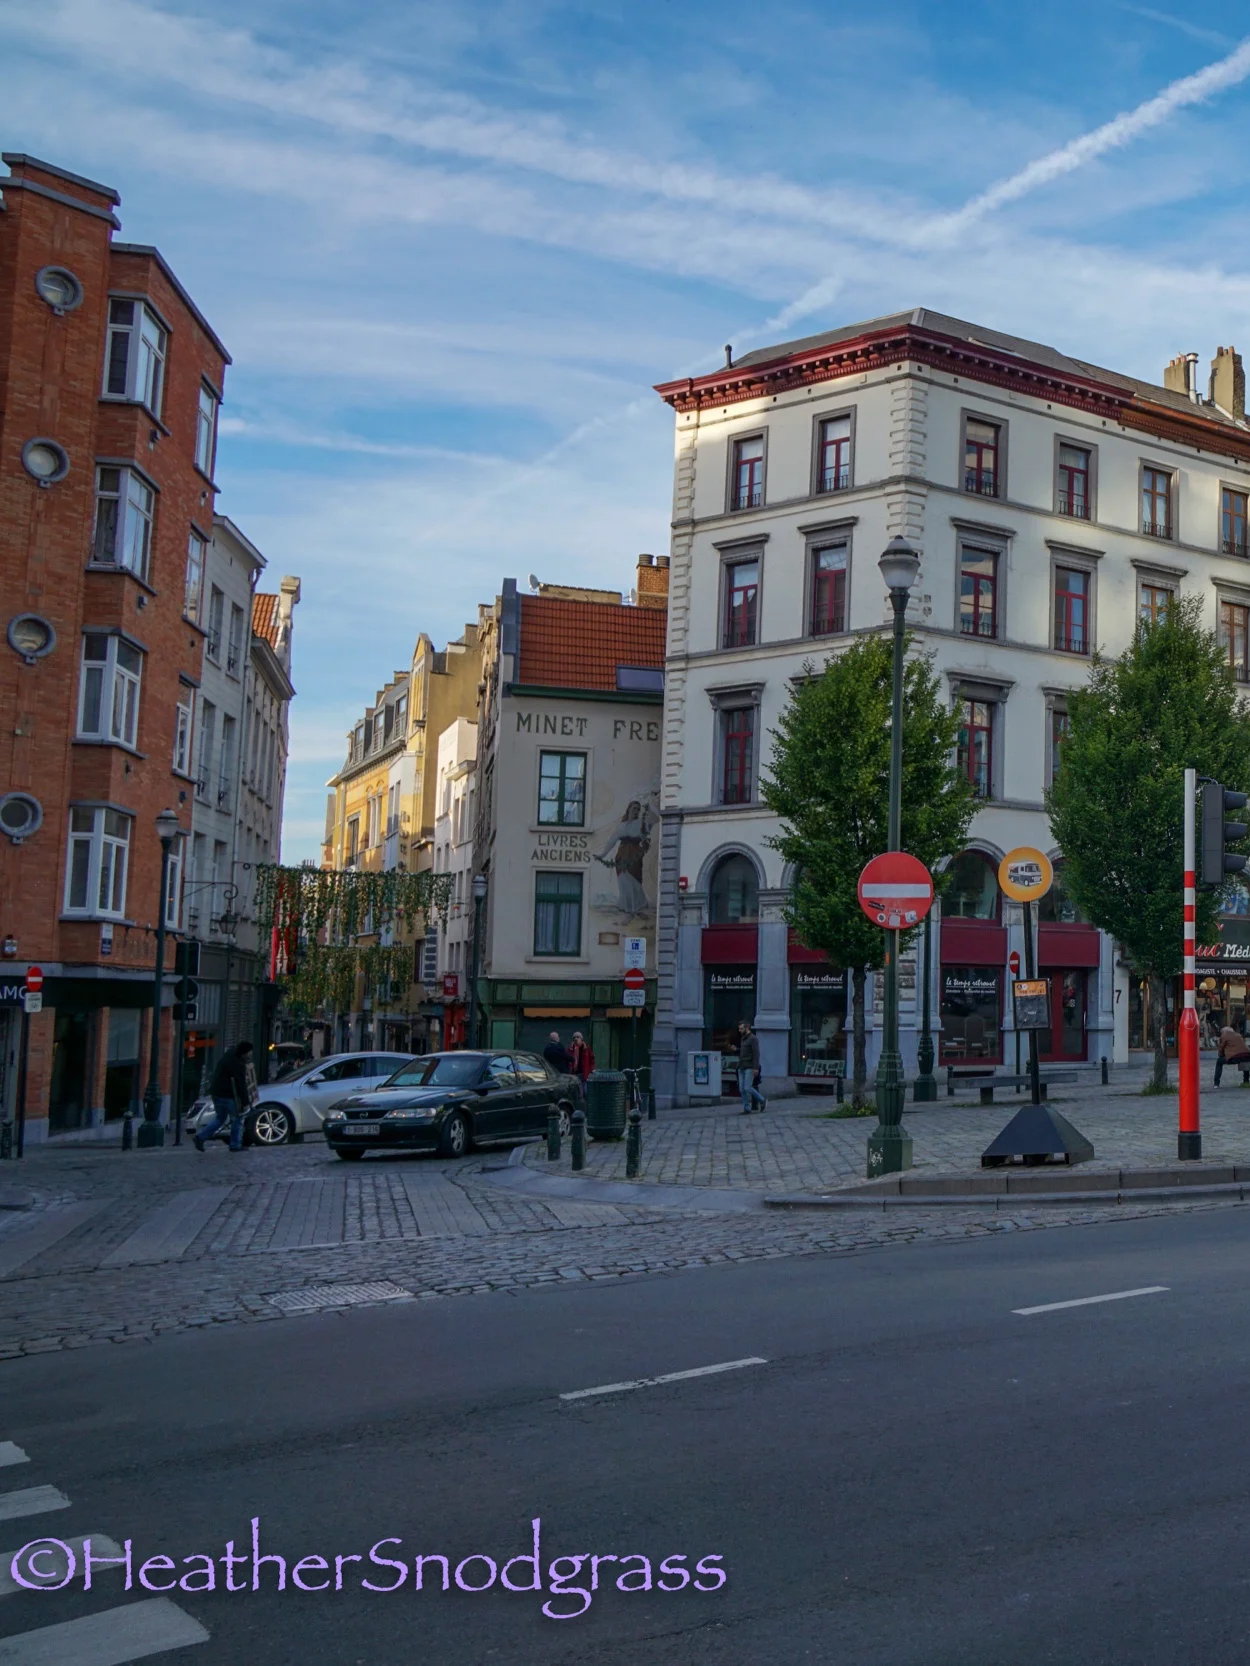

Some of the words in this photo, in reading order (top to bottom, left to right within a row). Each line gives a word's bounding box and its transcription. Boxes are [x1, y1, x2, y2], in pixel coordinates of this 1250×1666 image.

[516, 712, 588, 737] MINET
[538, 833, 588, 848] LIVRES
[531, 849, 591, 862] ANCIENS
[1115, 989, 1122, 1004] 7
